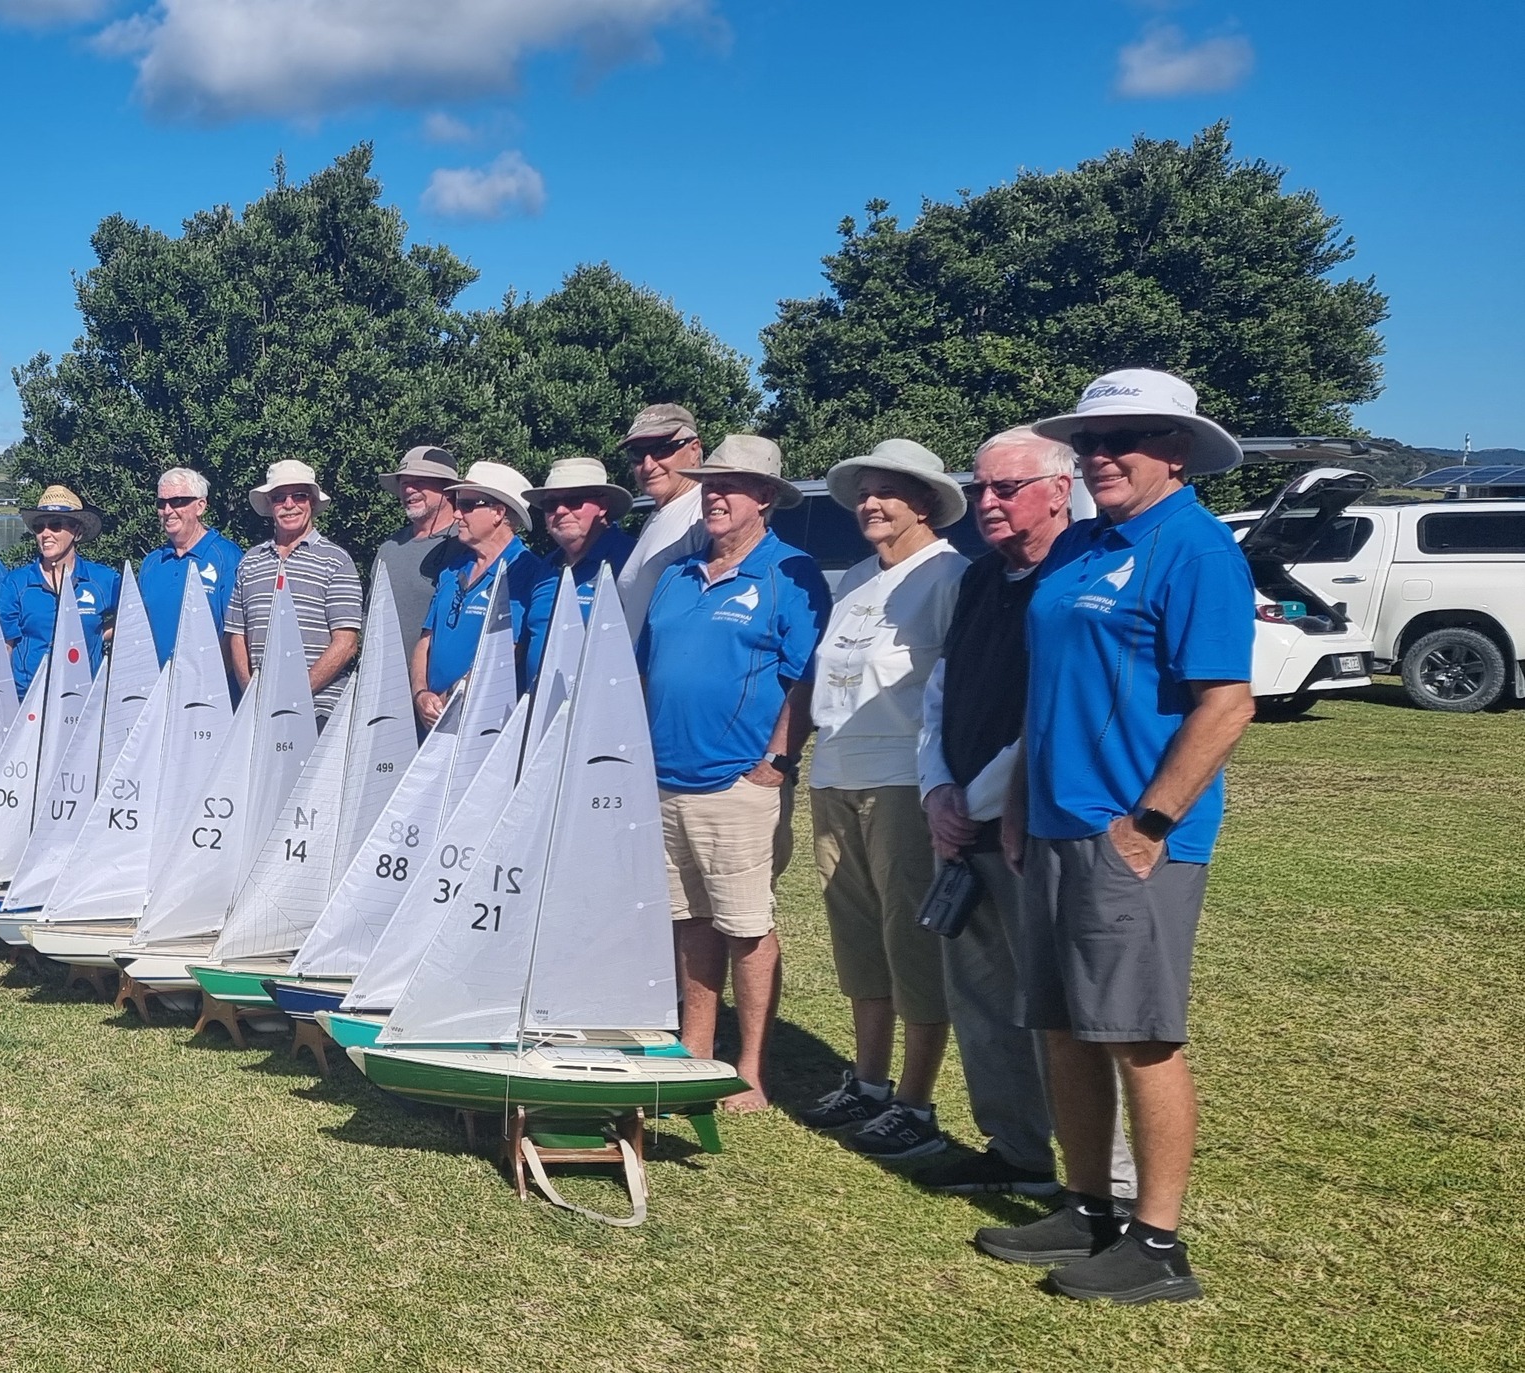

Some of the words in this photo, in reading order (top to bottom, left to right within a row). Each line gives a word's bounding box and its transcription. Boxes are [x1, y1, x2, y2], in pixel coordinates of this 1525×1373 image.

[1079, 384, 1143, 403] Titleist
[193, 730, 212, 741] 199
[275, 741, 294, 752] 864
[376, 762, 394, 773] 499
[51, 800, 77, 820] U7
[591, 796, 623, 809] 823
[108, 807, 138, 830] K5
[192, 827, 222, 850] C2
[284, 838, 307, 863] 14
[375, 853, 409, 881] 88
[471, 902, 502, 932] 21
